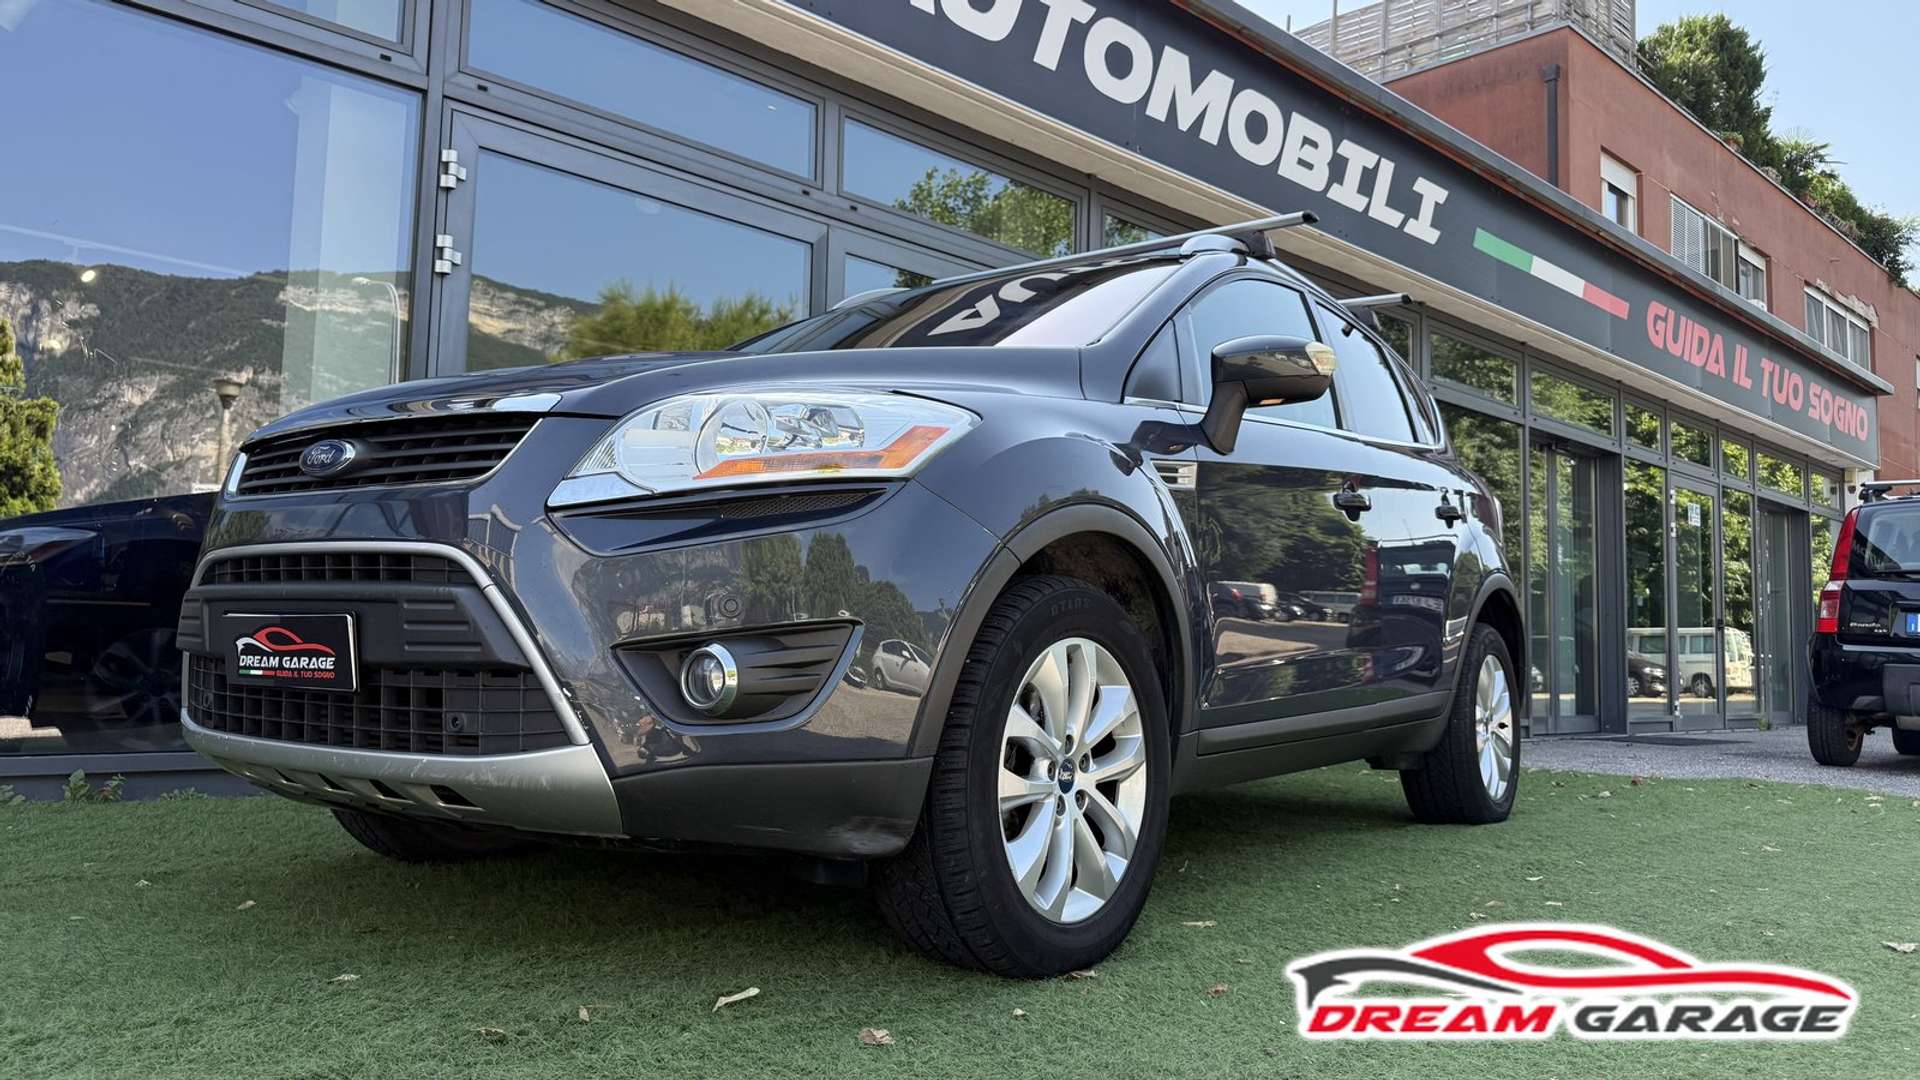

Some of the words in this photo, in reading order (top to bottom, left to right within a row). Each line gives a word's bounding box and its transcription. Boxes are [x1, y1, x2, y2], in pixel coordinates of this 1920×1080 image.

[910, 0, 1448, 244] TOMOBILI
[1646, 300, 1726, 378] GUIDA
[1733, 343, 1753, 390] IL
[1760, 356, 1805, 412] TUO
[1808, 382, 1868, 441] SOGNO
[307, 446, 336, 465] Ford
[239, 655, 279, 668] DREAM
[282, 656, 335, 670] GARAGE
